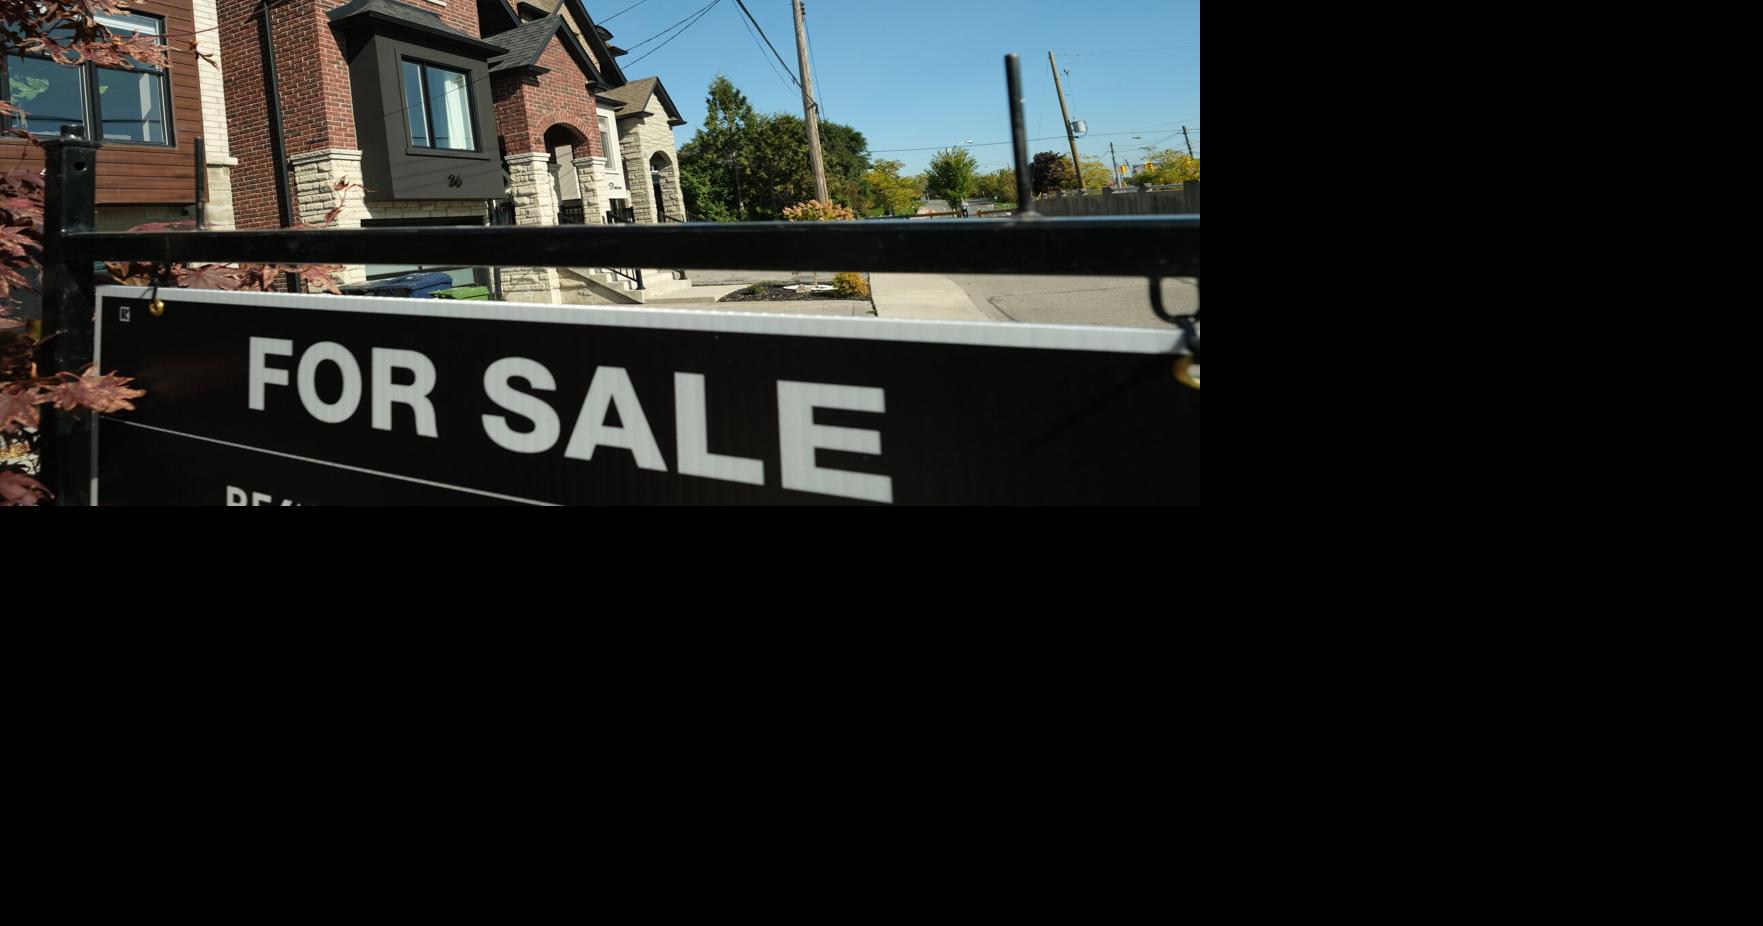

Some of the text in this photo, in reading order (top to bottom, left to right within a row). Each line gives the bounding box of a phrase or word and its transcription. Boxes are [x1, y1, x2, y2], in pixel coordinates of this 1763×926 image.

[448, 174, 463, 188] 36
[248, 336, 893, 504] FOR SALE
